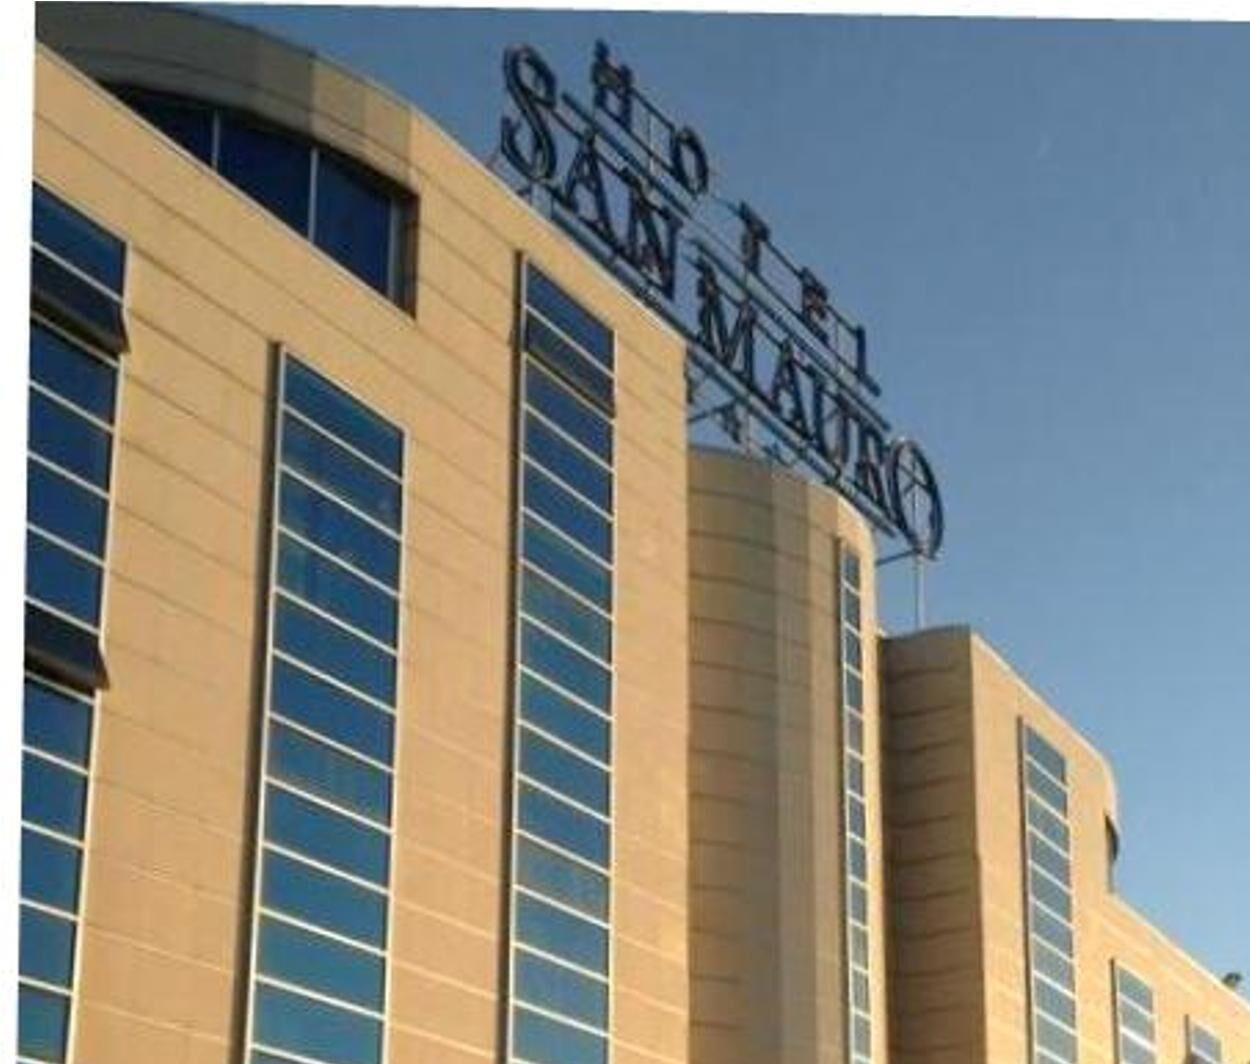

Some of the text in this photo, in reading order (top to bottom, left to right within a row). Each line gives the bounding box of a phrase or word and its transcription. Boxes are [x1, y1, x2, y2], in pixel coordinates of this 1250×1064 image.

[501, 43, 944, 559] SAN MAURO
[592, 39, 880, 396] HOTEL
